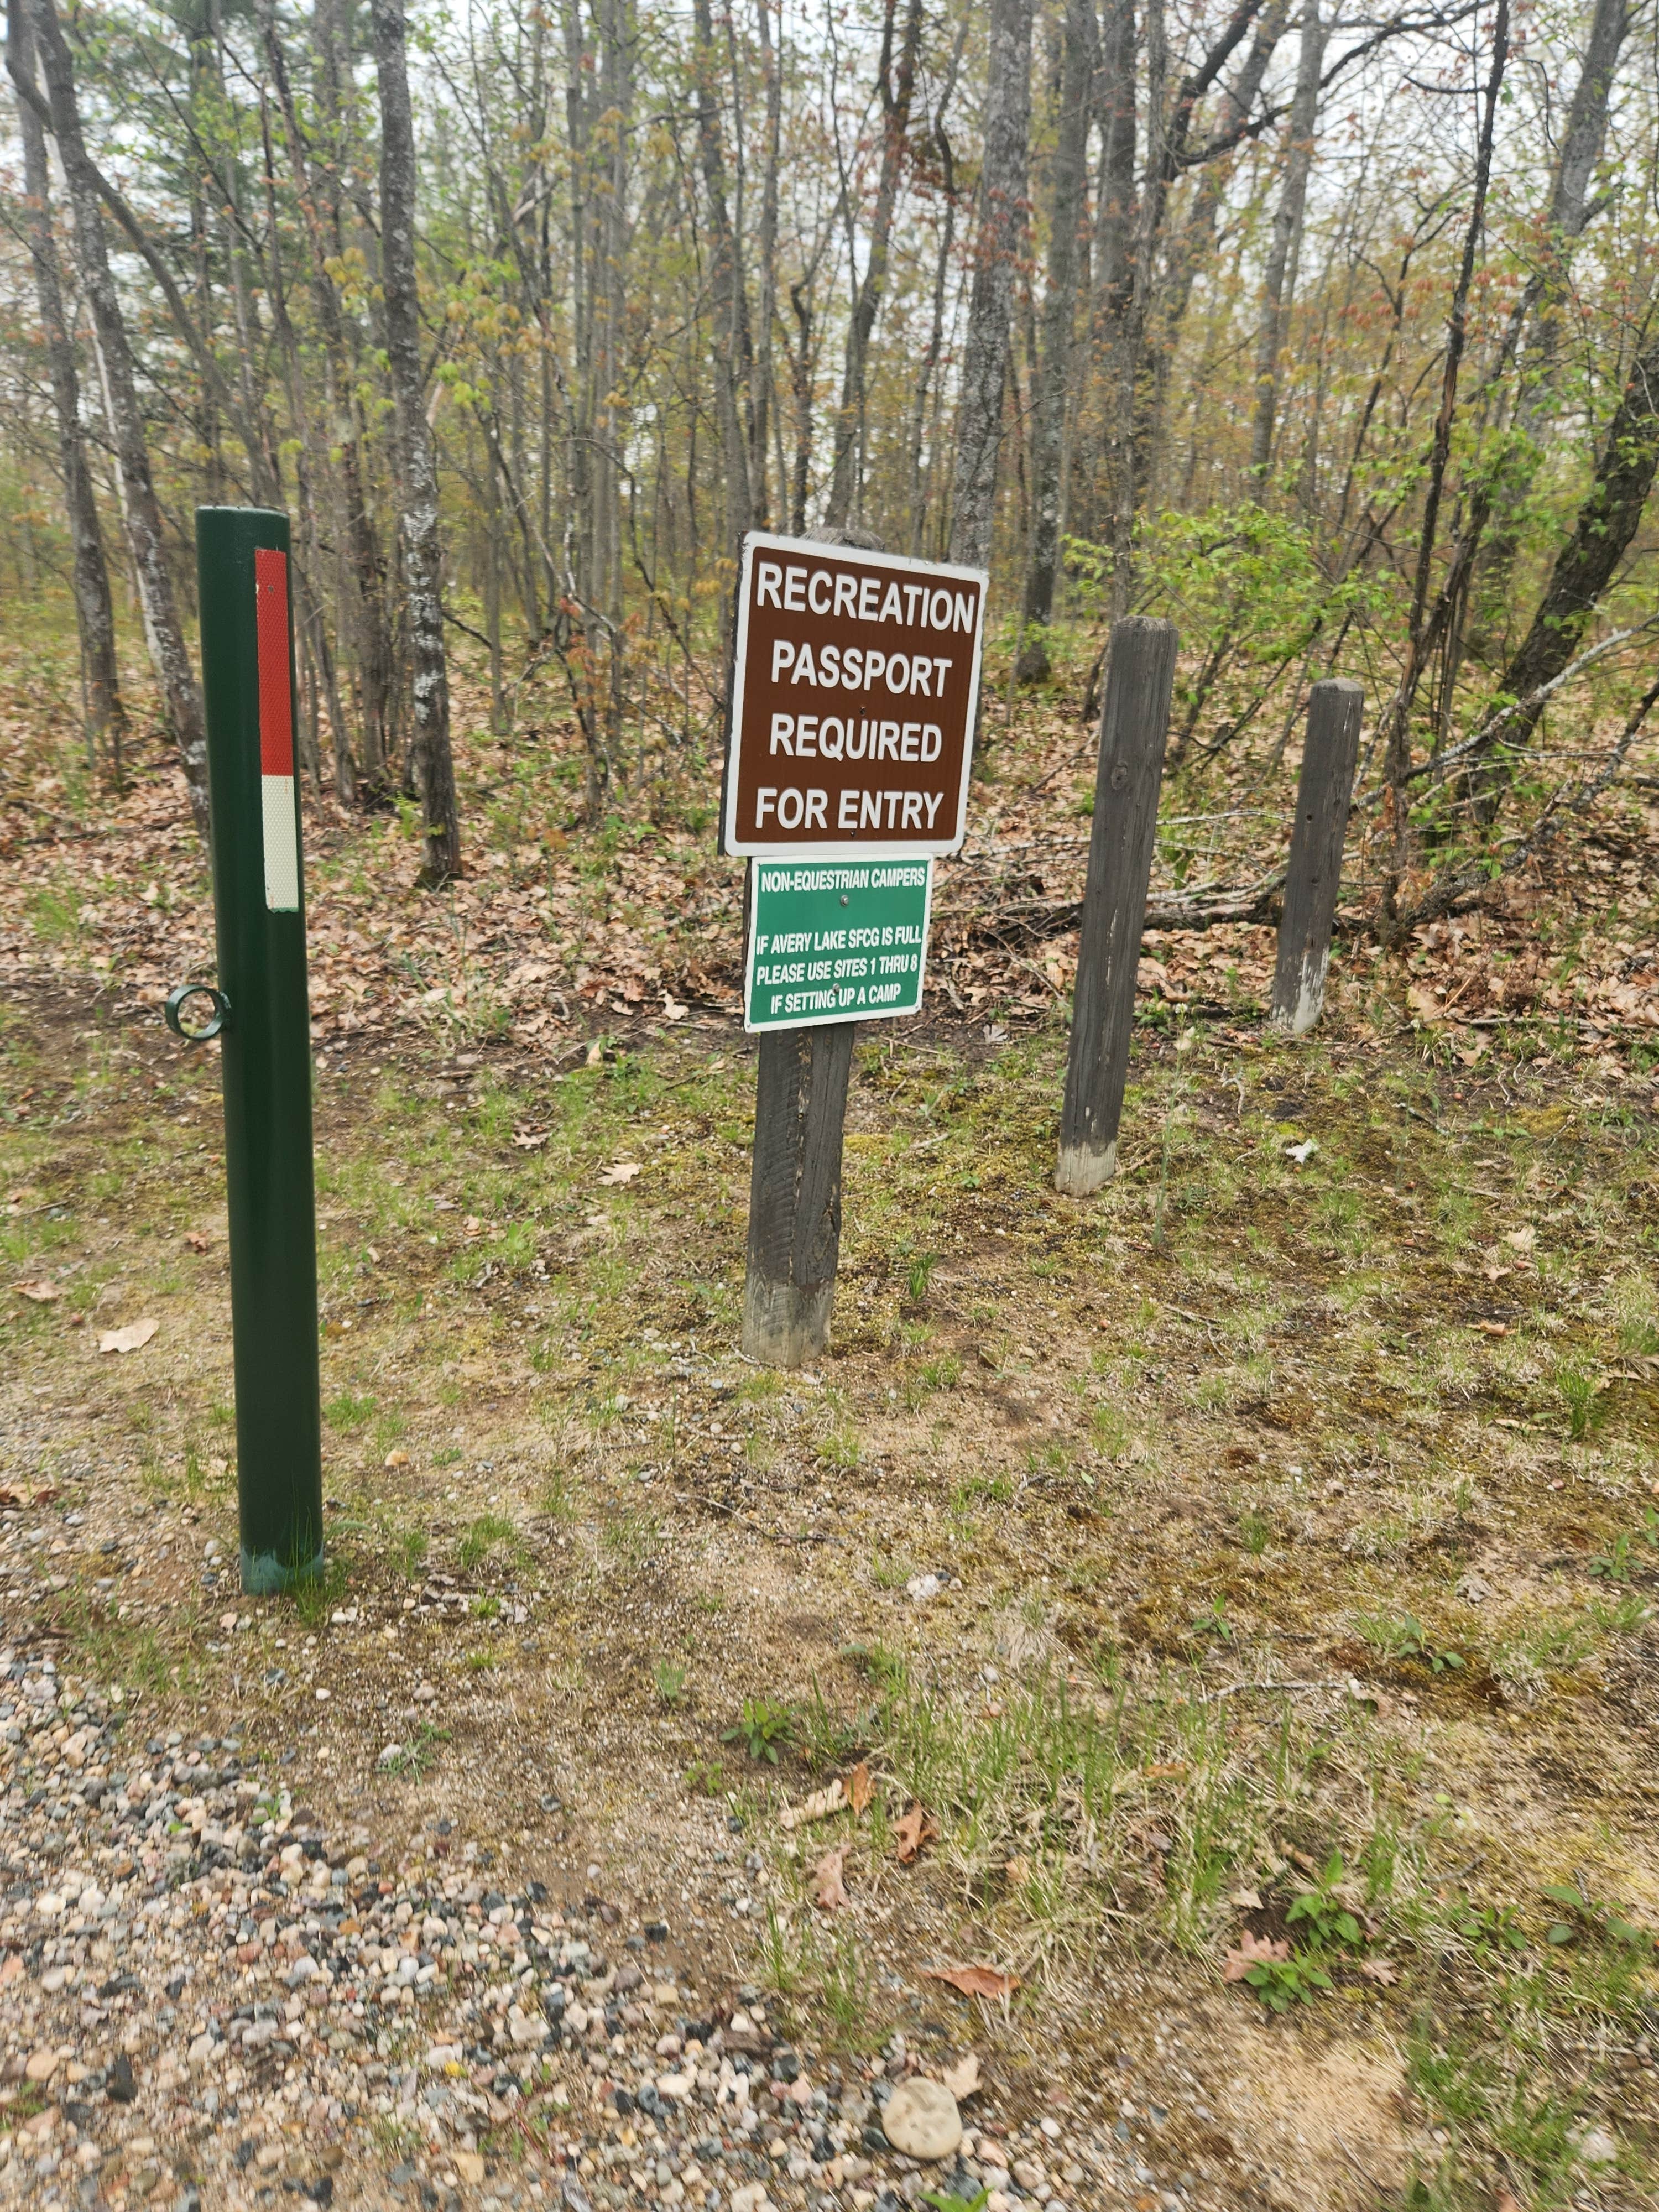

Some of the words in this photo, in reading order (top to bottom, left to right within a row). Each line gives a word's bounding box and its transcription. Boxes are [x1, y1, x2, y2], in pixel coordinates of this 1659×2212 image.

[757, 562, 974, 634] RECREATION
[771, 640, 952, 697] PASSPORT
[770, 713, 942, 762] REQUIRED
[755, 787, 828, 829] FOR
[838, 790, 943, 830] ENTRY
[761, 869, 869, 892] NON-EQUESTRIAN
[871, 867, 925, 888] CAMPERS
[757, 935, 769, 955] IF
[770, 932, 812, 954] AVERY
[814, 930, 846, 951] LAKE
[848, 927, 879, 948] SFCG
[881, 926, 893, 946] IS
[894, 925, 921, 945] FULL
[757, 963, 805, 985] PLEASE
[807, 961, 832, 982] USE
[833, 957, 868, 979] SITES
[870, 957, 875, 975] 1
[879, 954, 909, 974] THRU
[910, 953, 918, 972] 8
[771, 995, 783, 1014] IF
[784, 989, 836, 1013] SETTING
[838, 987, 855, 1006] UP
[857, 986, 865, 1005] A
[869, 983, 901, 1004] CAMP
